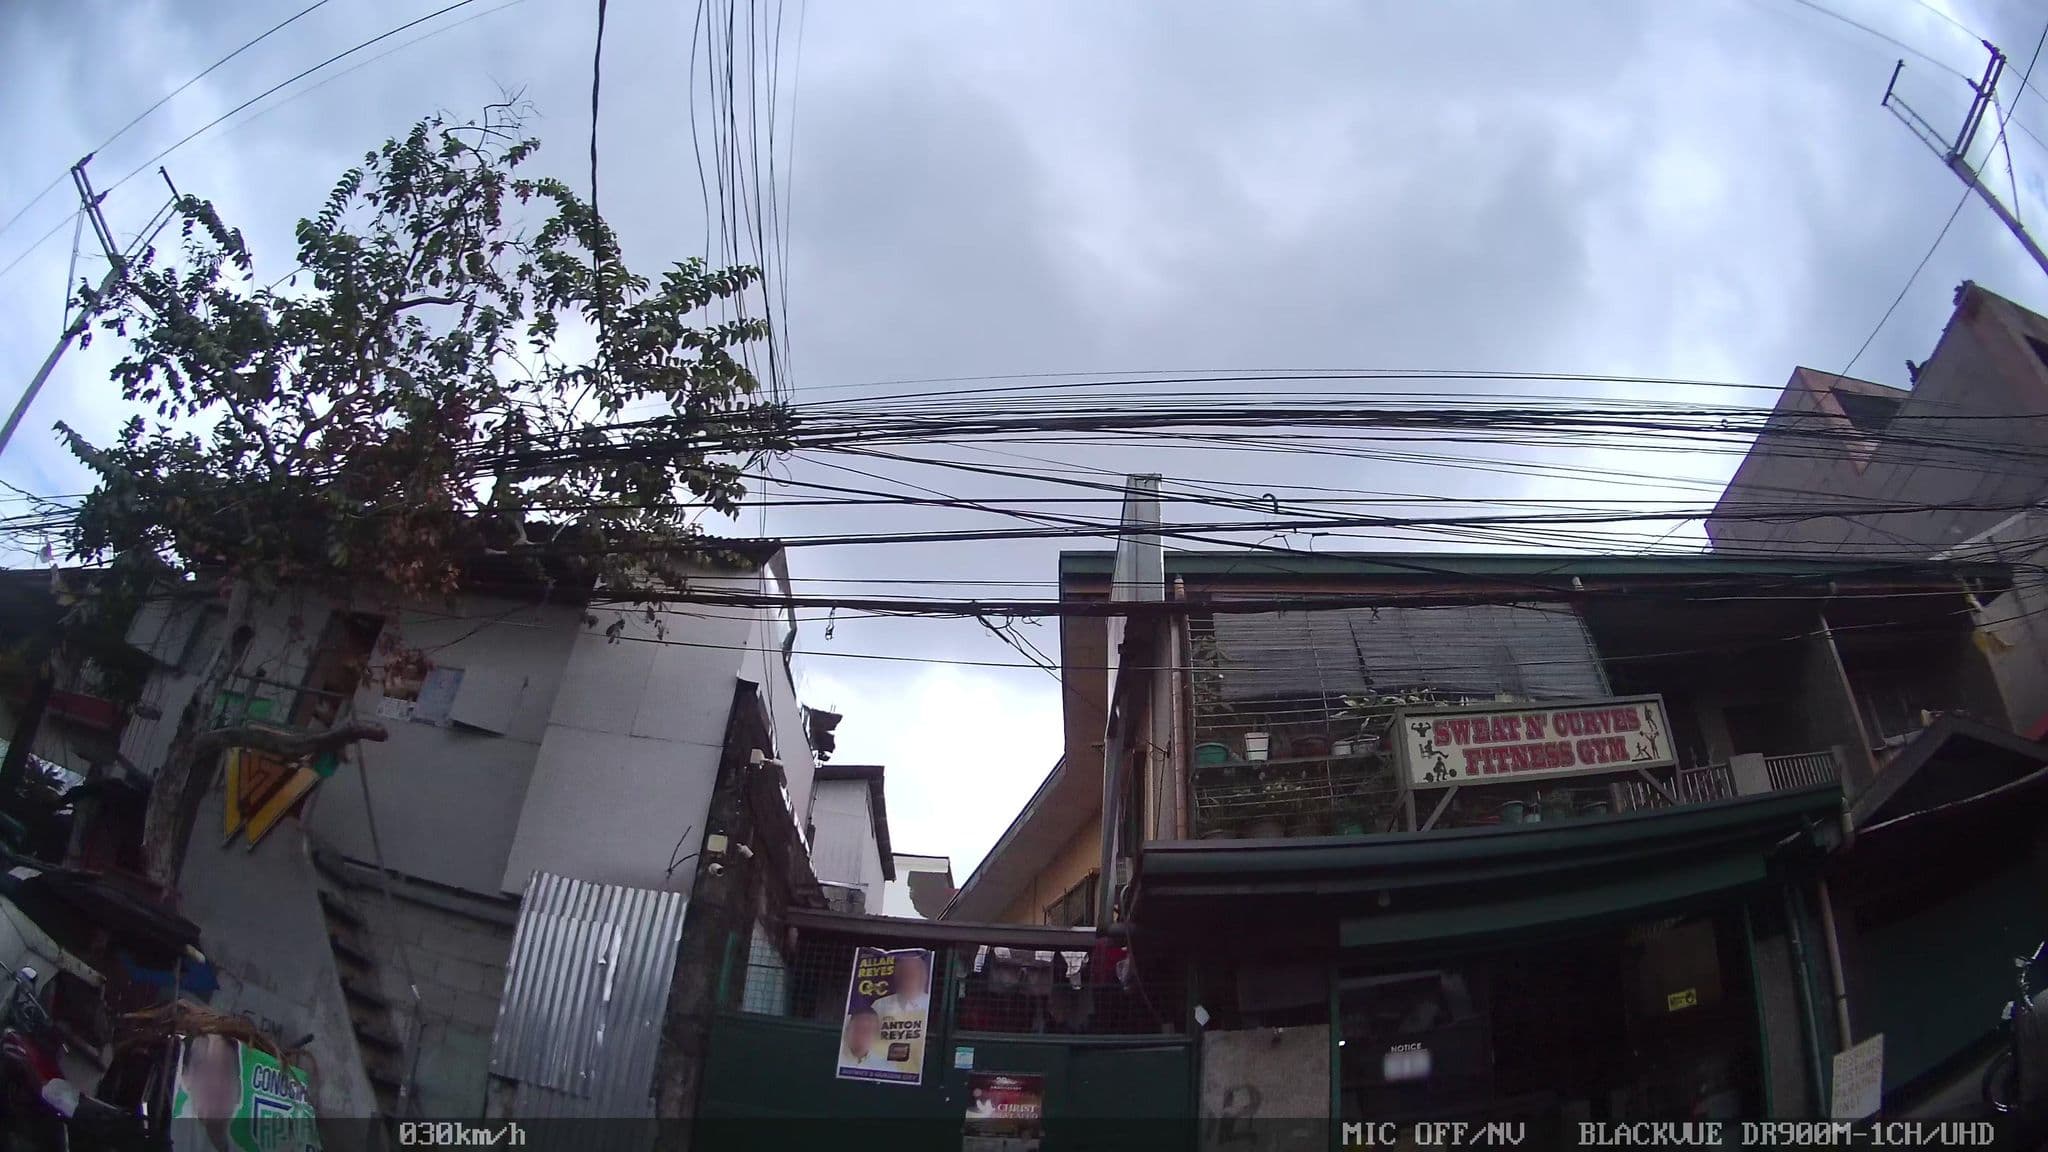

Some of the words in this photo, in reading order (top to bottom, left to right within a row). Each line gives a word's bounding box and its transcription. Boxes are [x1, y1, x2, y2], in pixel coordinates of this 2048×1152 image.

[1433, 714, 1521, 747] SWEAT
[1552, 706, 1641, 738] CURVES
[1462, 740, 1576, 776] FITNESS
[1576, 736, 1631, 764] GYM
[860, 956, 895, 967] ALLAN
[858, 966, 894, 977] REYES
[881, 1020, 922, 1030] ANTON
[880, 1030, 921, 1040] REYES
[1391, 1043, 1422, 1053] NOTICE
[997, 1103, 1038, 1114] CHRIST
